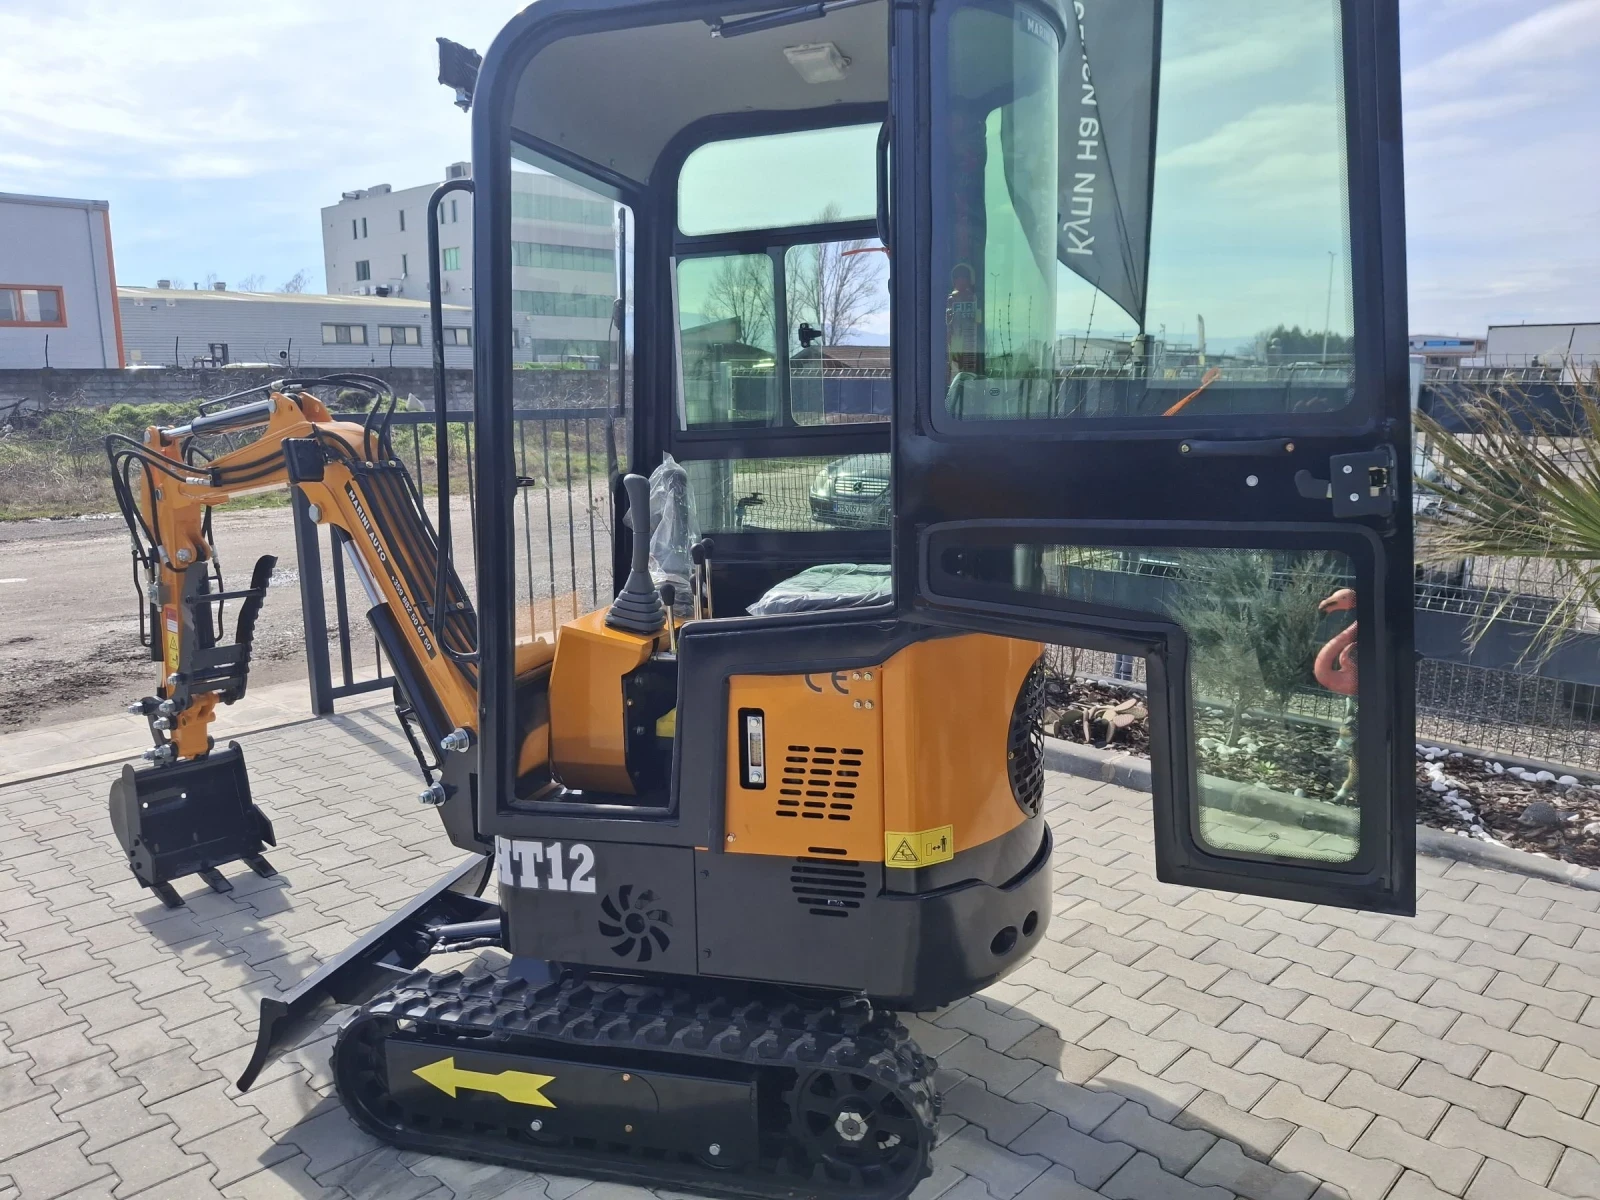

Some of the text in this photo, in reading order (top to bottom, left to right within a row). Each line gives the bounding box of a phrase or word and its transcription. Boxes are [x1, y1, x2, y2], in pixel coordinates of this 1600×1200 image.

[348, 489, 386, 562] MARINI AUTO
[497, 836, 596, 893] HT12
